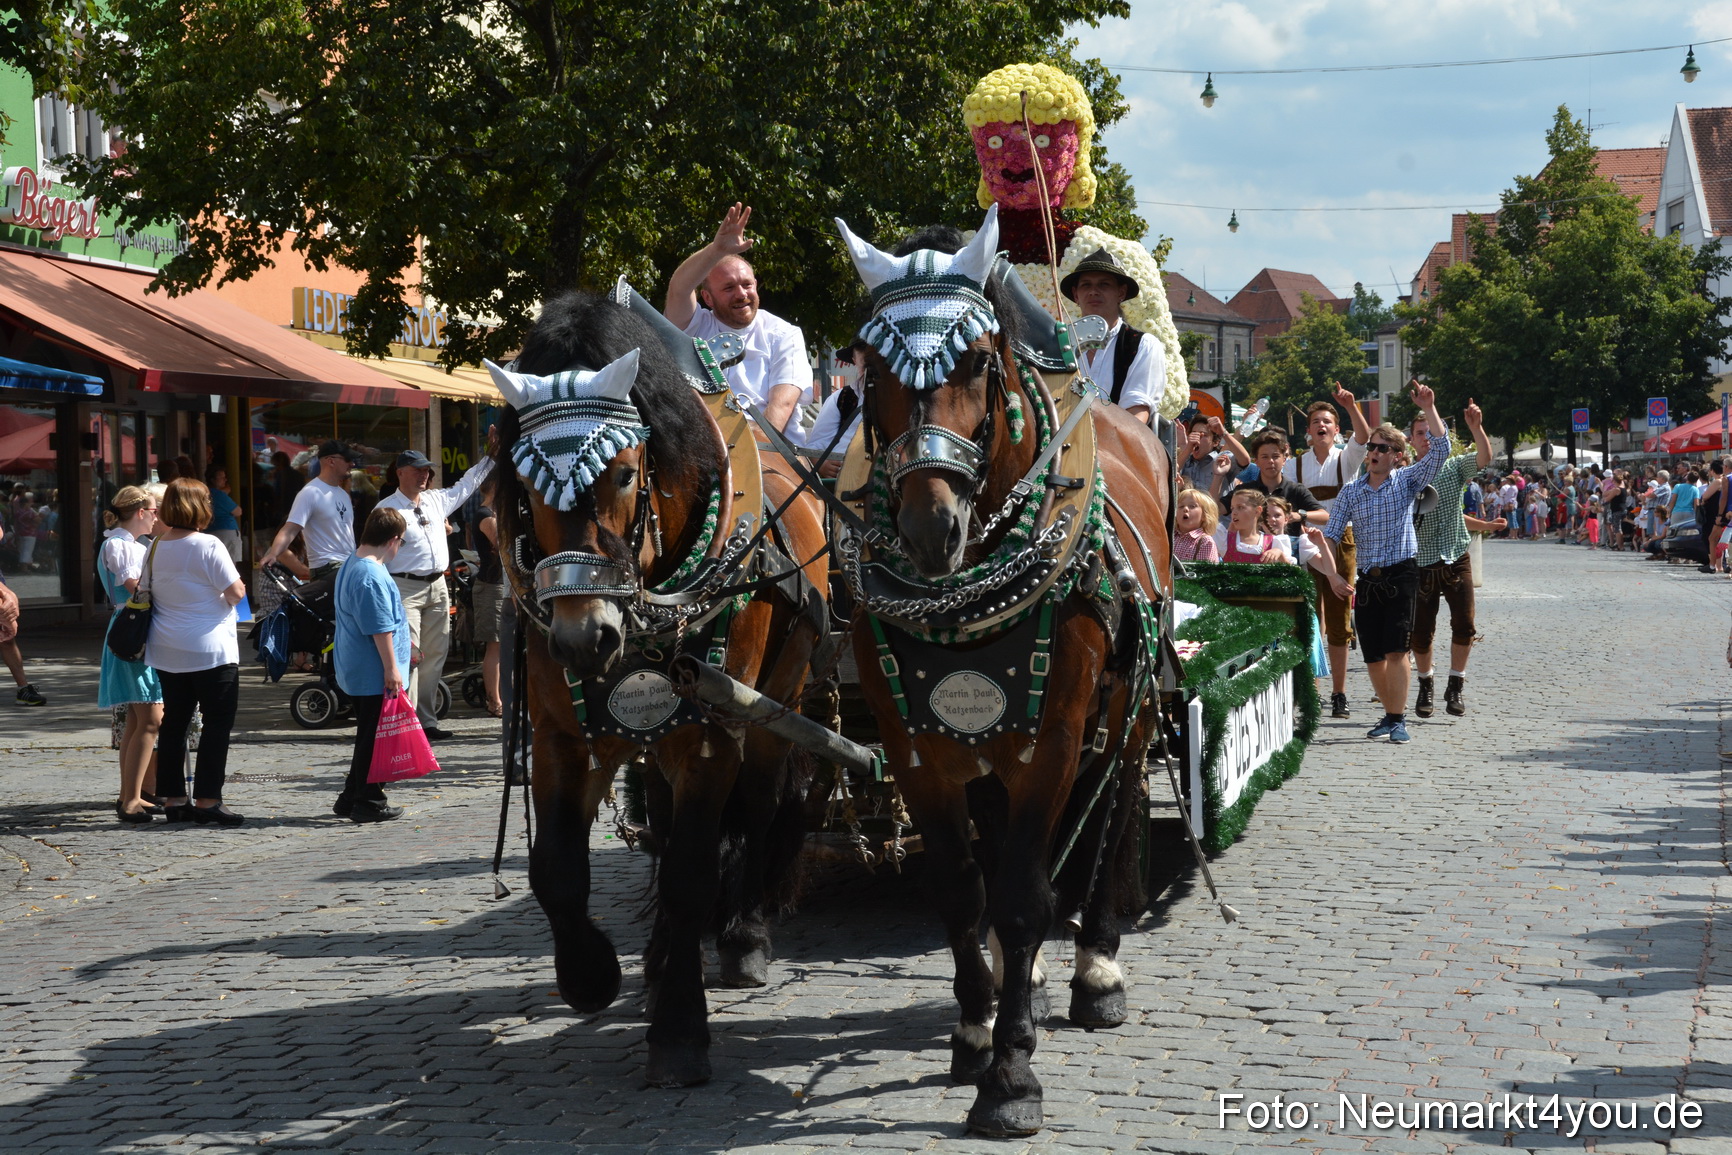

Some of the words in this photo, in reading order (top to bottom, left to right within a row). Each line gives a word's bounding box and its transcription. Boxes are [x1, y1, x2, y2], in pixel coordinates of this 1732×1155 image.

[12, 166, 101, 241] Bögerl
[1650, 417, 1666, 425] TAXI
[615, 688, 645, 701] Martin
[648, 683, 672, 698] Pauli
[938, 688, 969, 699] Martin
[973, 688, 996, 700] Pauli
[943, 704, 994, 716] Katzenbach
[391, 753, 412, 763] ADLER
